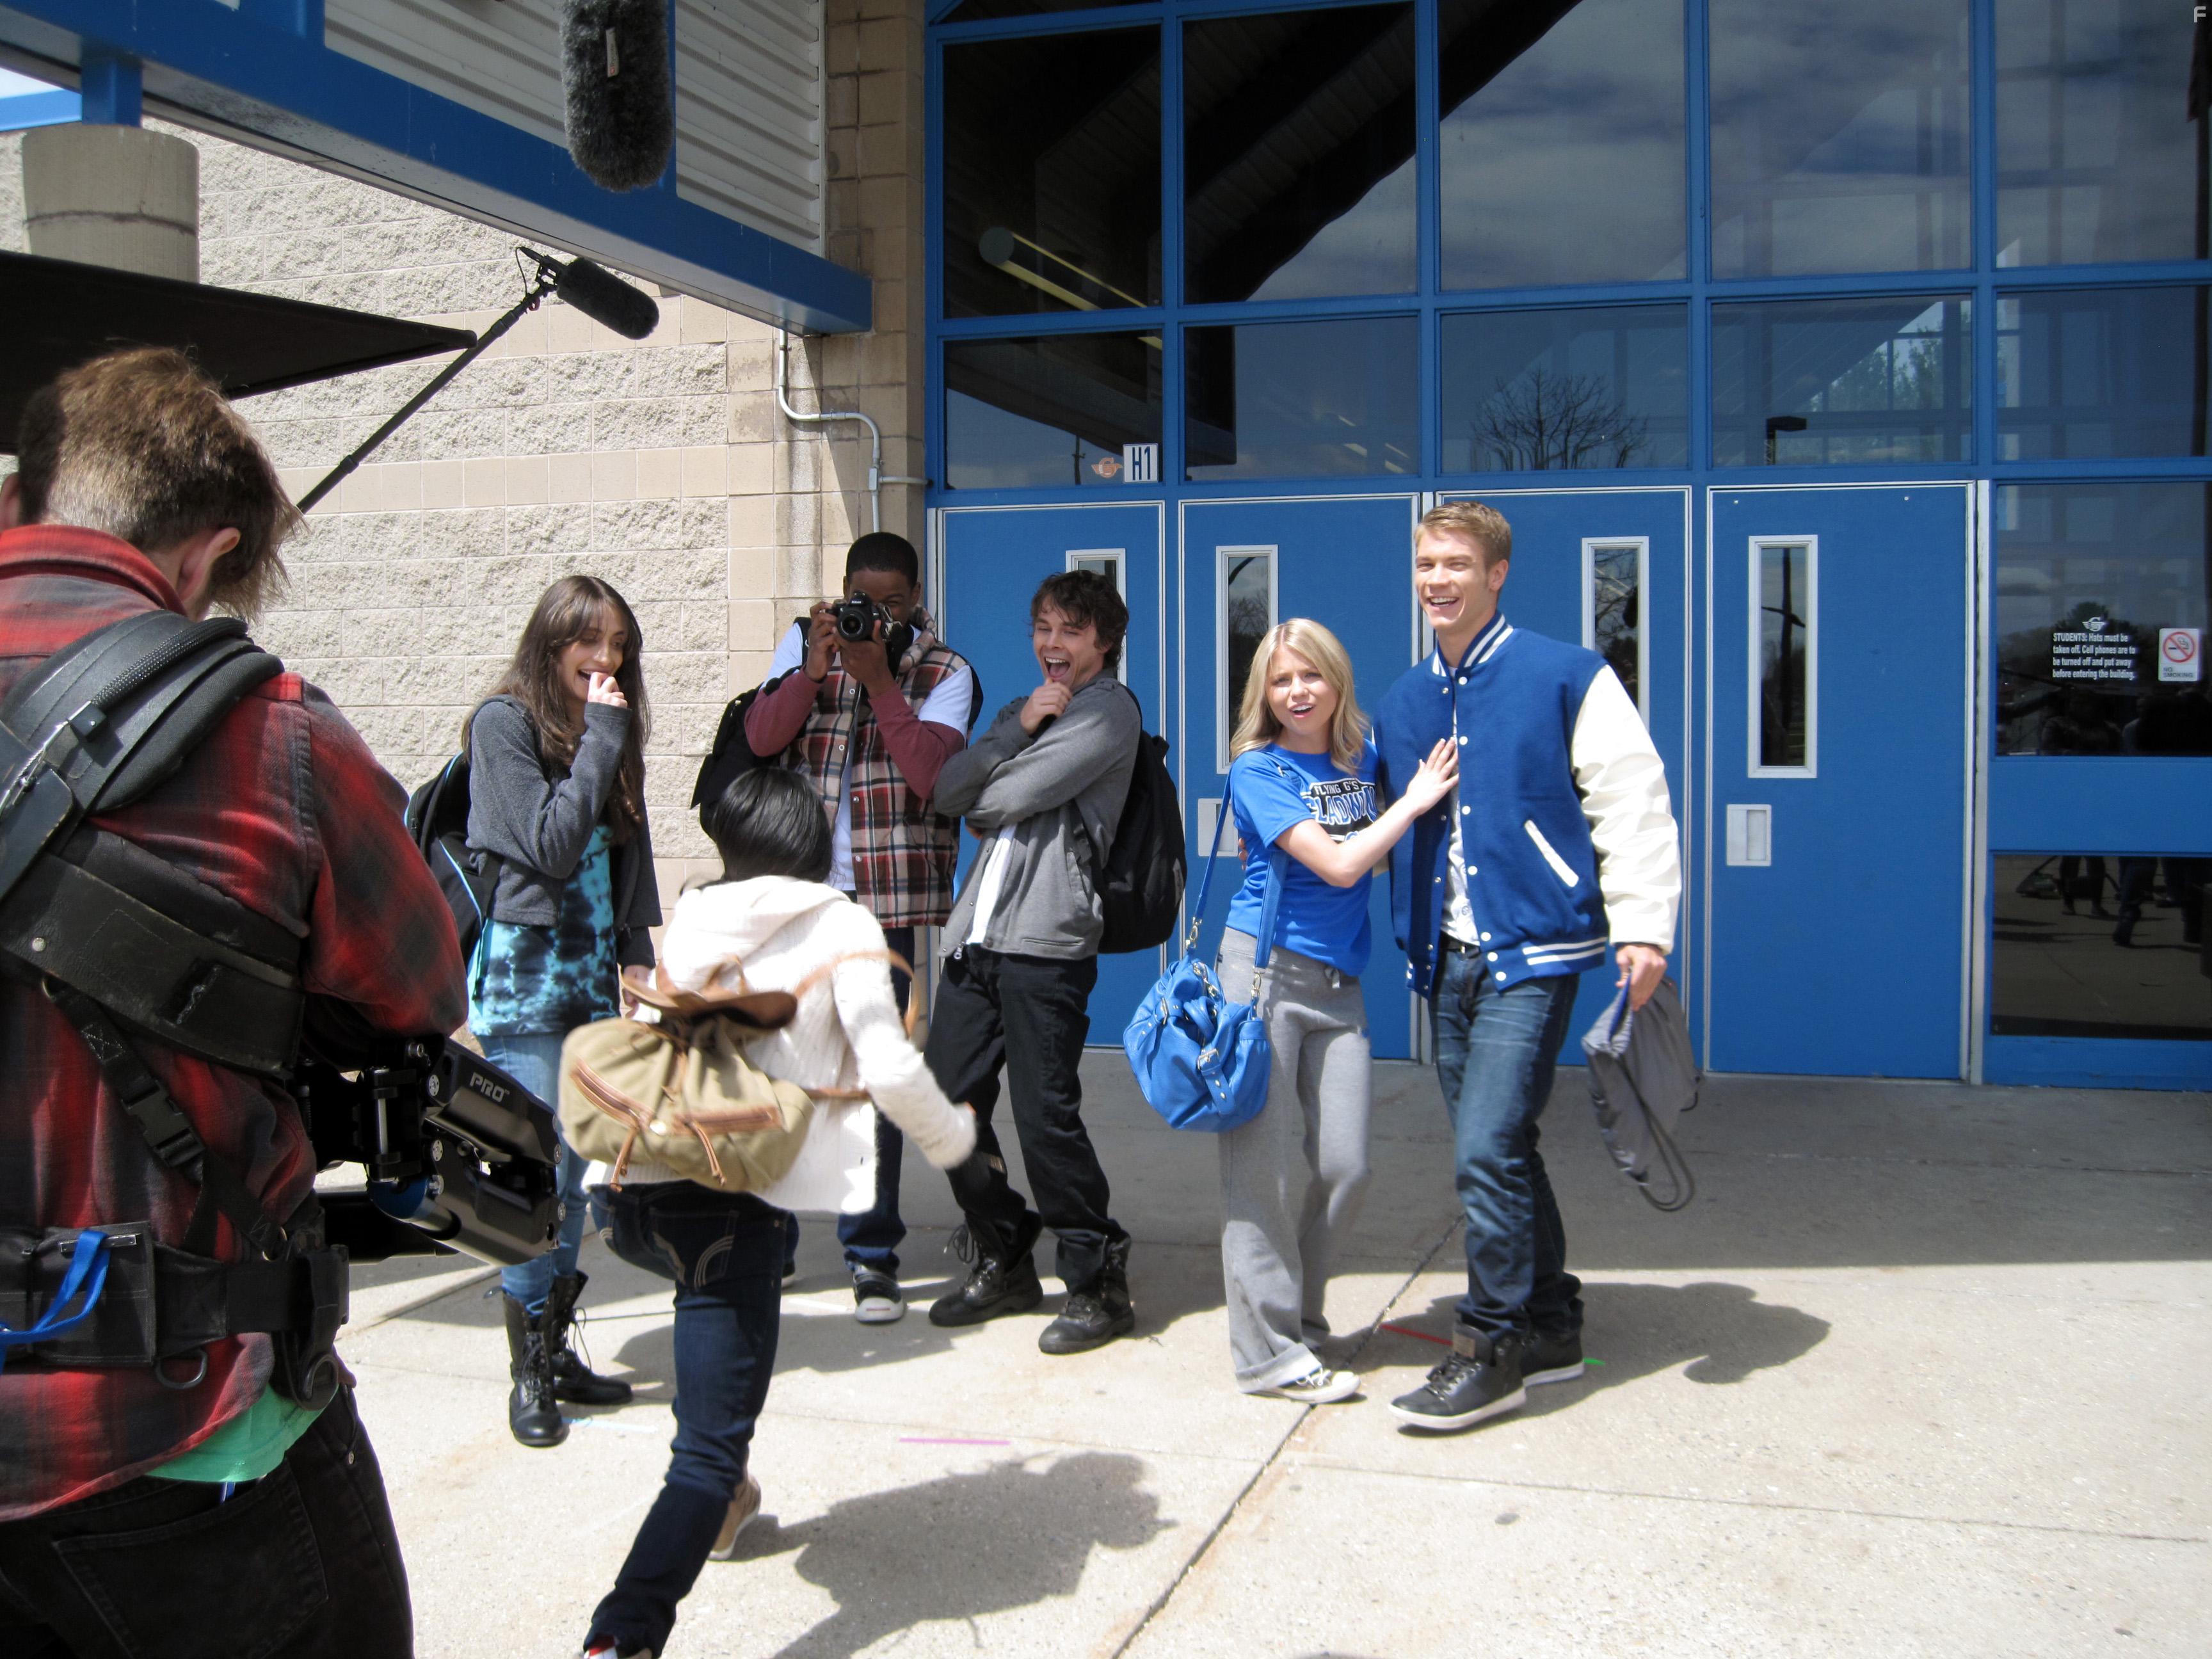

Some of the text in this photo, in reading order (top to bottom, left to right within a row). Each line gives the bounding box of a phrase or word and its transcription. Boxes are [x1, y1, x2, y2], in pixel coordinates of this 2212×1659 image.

[1132, 446, 1151, 481] H1
[2053, 632, 2087, 641] STUDENTS:
[2088, 632, 2103, 641] Hats
[2120, 632, 2128, 641] be
[2053, 645, 2070, 653] taken
[2071, 645, 2081, 653] off.
[2081, 645, 2094, 653] Cell
[2094, 645, 2117, 656] phones
[2129, 645, 2136, 654] to
[2053, 657, 2132, 668] be turned off and put away
[2052, 669, 2135, 680] before entering the building.
[1314, 781, 1359, 795] FLYING G'S
